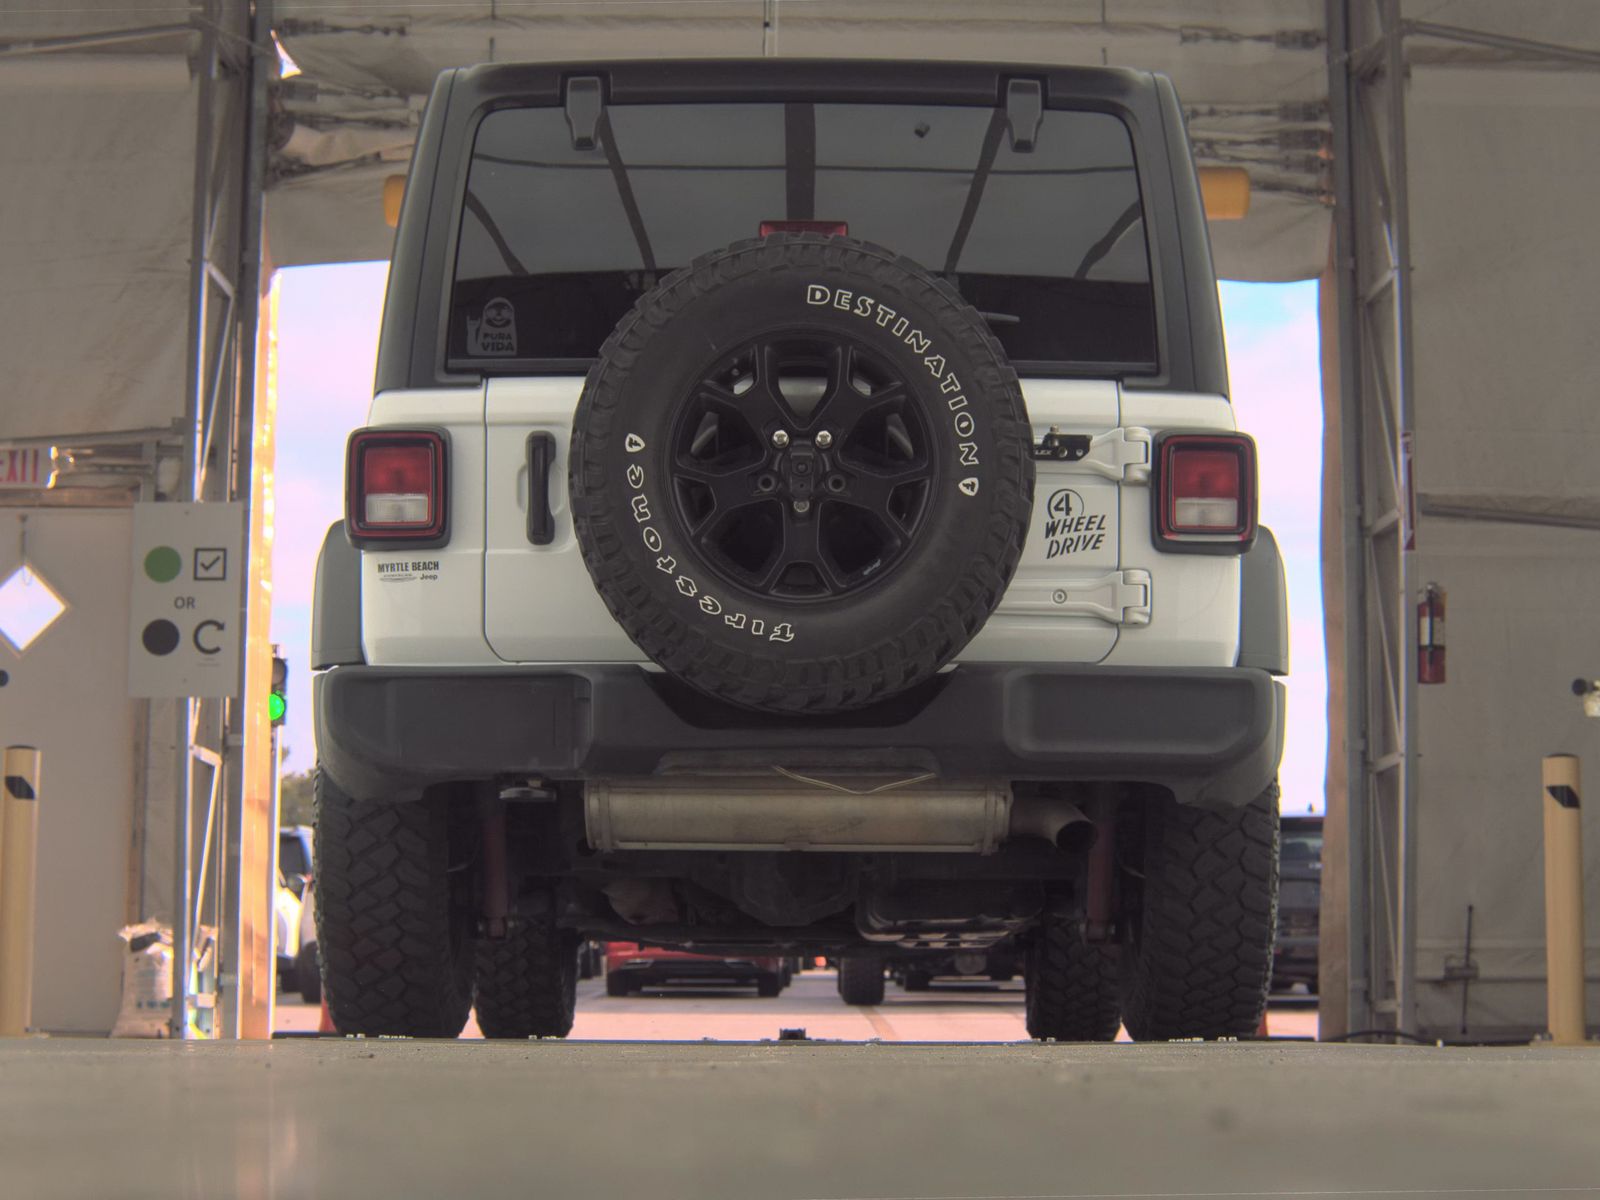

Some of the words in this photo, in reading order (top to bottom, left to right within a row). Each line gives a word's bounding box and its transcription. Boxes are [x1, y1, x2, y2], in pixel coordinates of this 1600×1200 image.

[483, 332, 513, 341] PURA
[481, 342, 515, 352] VIDA
[807, 284, 979, 466] DESTINATION
[1053, 493, 1072, 516] 4
[1045, 514, 1106, 539] WHEEL
[626, 464, 795, 642] Firestone
[1046, 533, 1105, 560] DRIVE
[377, 562, 409, 573] MYRTLE
[411, 560, 439, 571] BEACH
[420, 573, 438, 581] Jeep
[174, 596, 195, 610] OR
